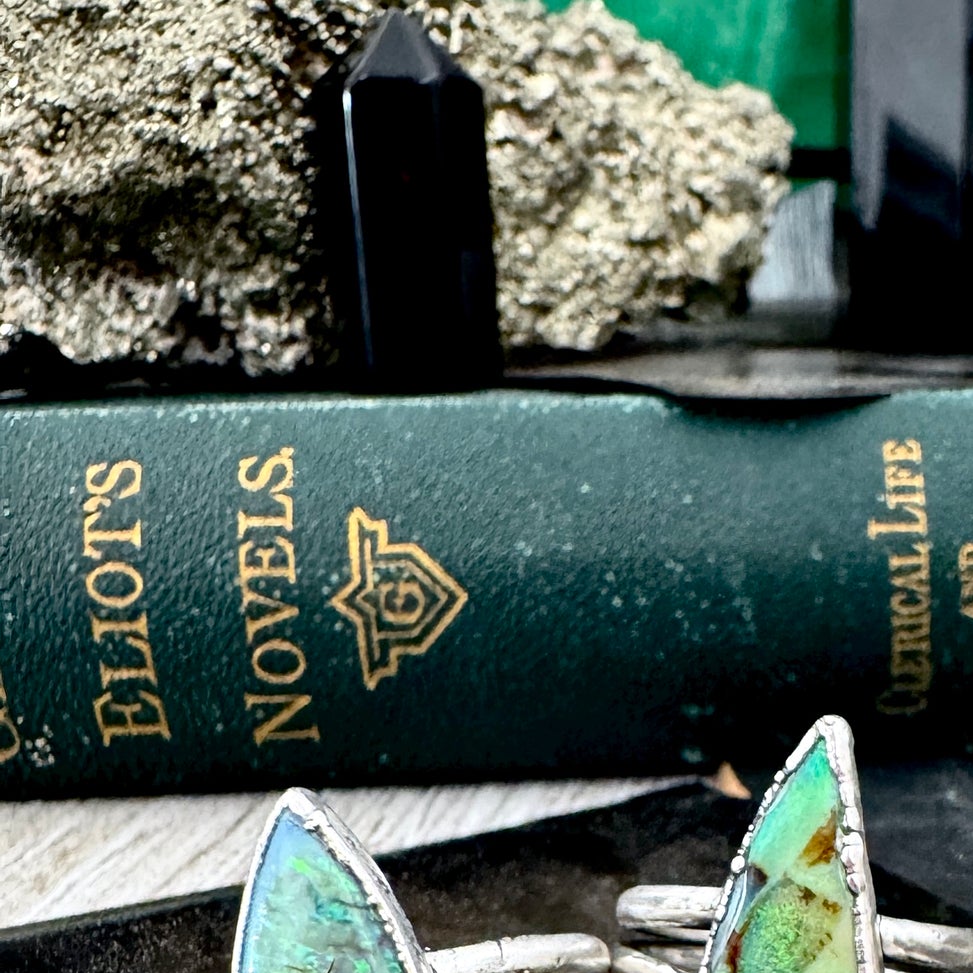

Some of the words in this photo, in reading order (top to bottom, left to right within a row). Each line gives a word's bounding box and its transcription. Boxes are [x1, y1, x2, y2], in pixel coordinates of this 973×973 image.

[867, 437, 928, 540] LIFE
[83, 458, 171, 748] ELIOT'S
[875, 540, 934, 716] CLERICAL
